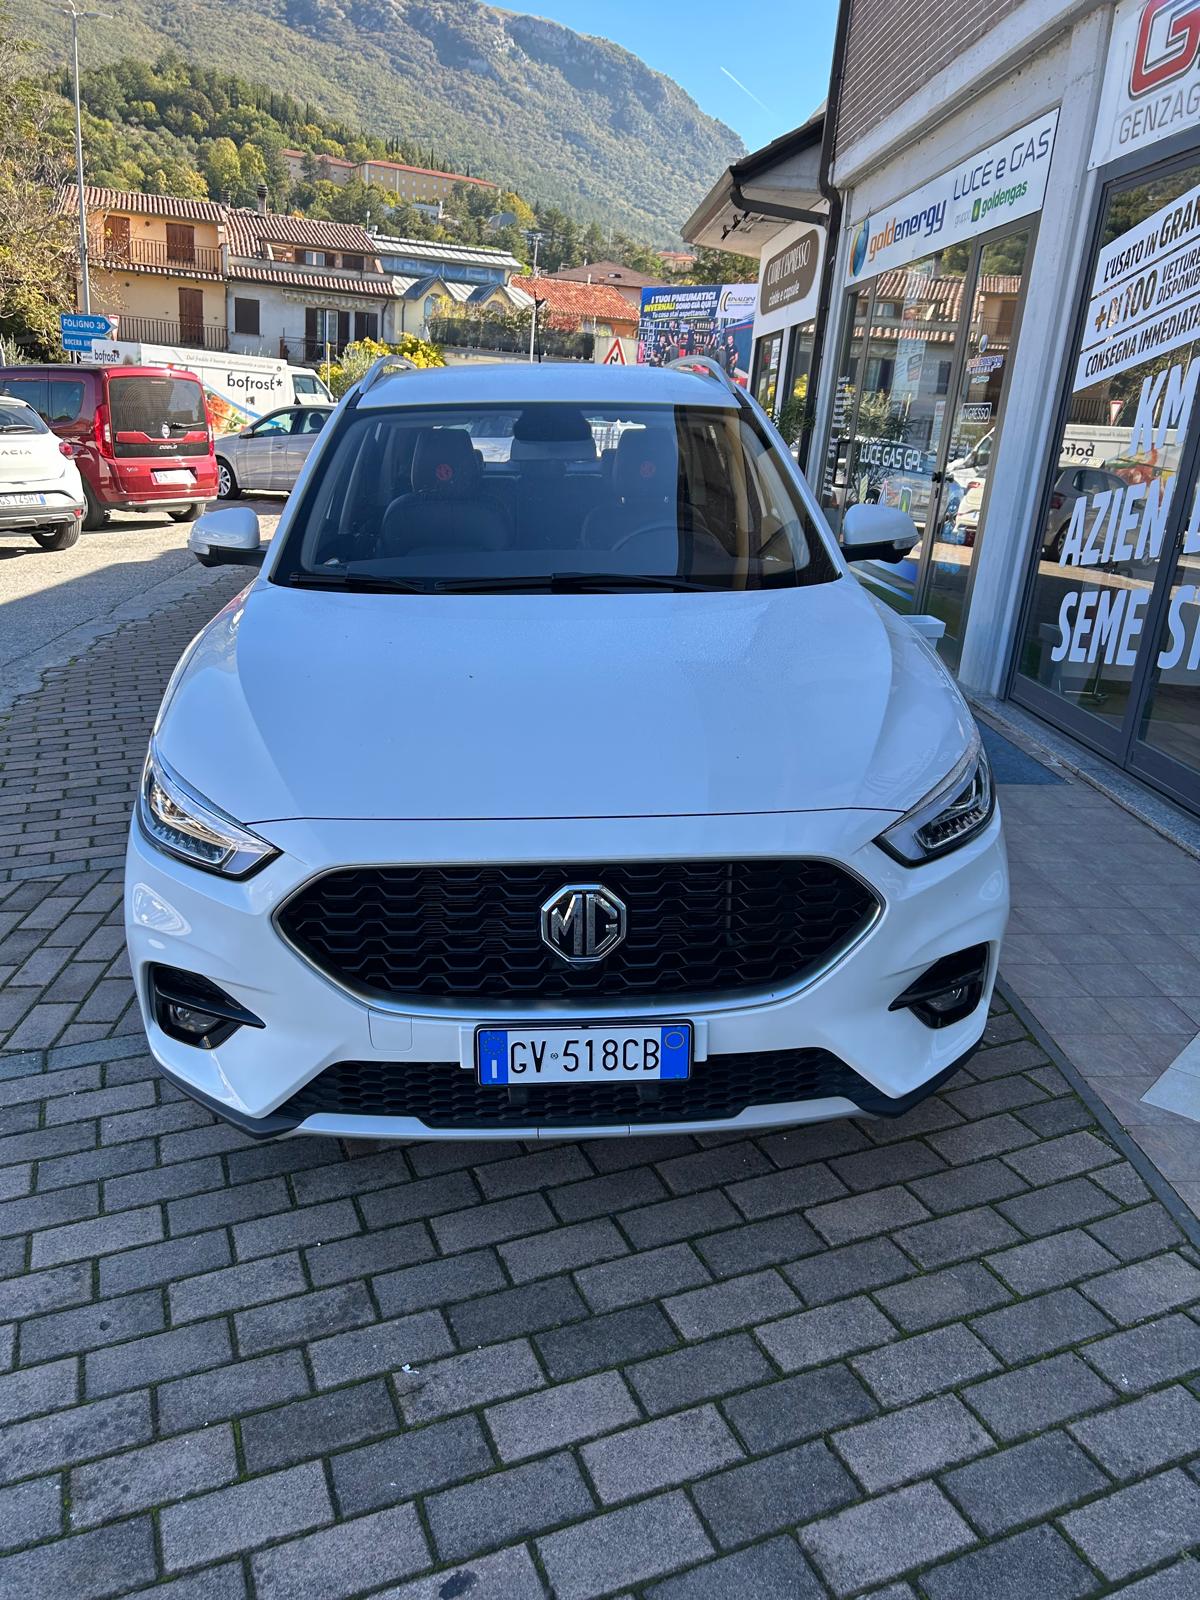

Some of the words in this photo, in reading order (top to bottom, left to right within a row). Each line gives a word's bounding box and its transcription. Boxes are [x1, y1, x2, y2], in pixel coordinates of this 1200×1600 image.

[953, 160, 994, 201] LUCE
[995, 158, 1007, 180] e
[1010, 128, 1052, 173] GAS
[981, 181, 1028, 220] goldengas
[868, 199, 947, 263] goldenergy
[1103, 240, 1145, 284] L'USATO
[1144, 230, 1159, 259] IN
[655, 294, 671, 303] TUOI
[671, 291, 716, 302] PNEUMATICI
[1122, 268, 1158, 322] 100
[63, 319, 94, 329] FOLIGNO
[1085, 333, 1137, 378] CONSEGNA
[860, 443, 882, 465] LUCE
[883, 446, 904, 469] GAS
[904, 449, 923, 472] GPL
[551, 893, 618, 956] MG
